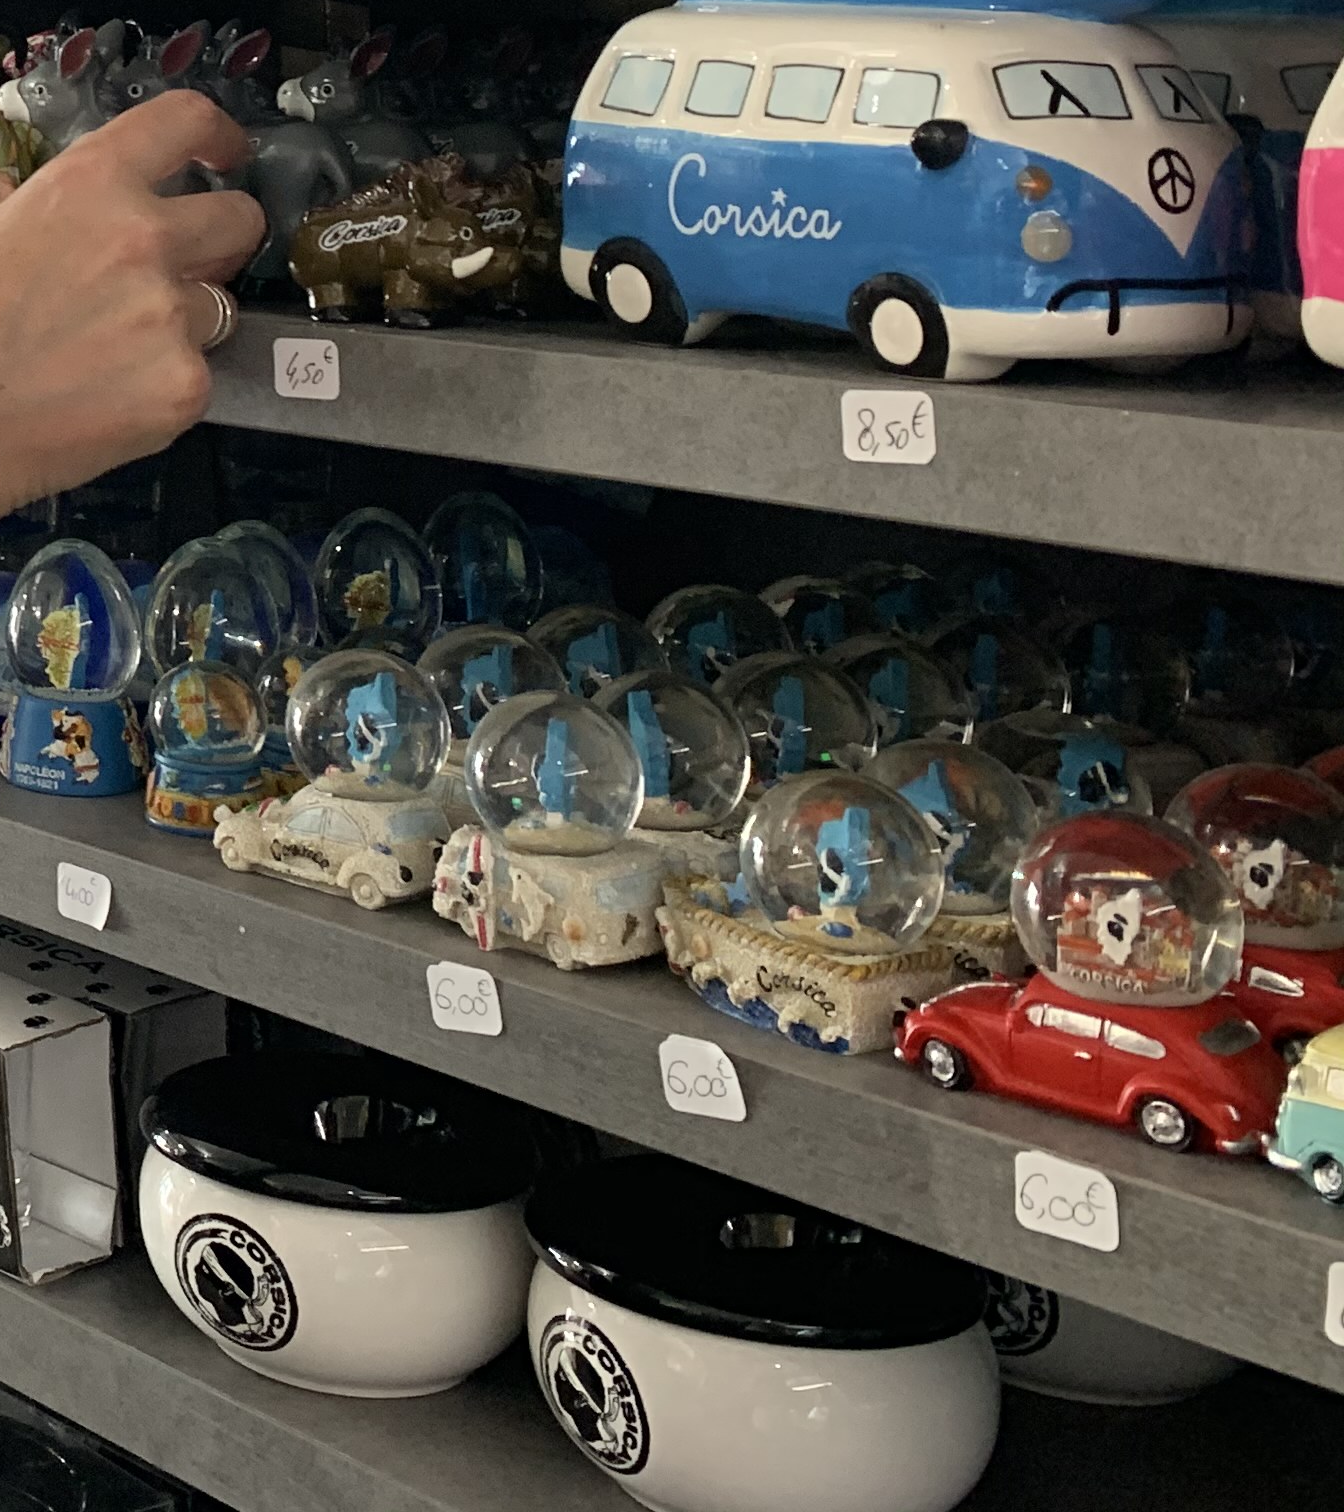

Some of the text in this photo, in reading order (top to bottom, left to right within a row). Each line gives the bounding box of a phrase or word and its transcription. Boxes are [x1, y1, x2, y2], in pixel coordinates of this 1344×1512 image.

[667, 151, 843, 242] Corsica
[318, 214, 408, 251] Corsica
[285, 345, 333, 389] 4,50€
[856, 400, 928, 456] 8,50€
[755, 964, 839, 1019] Corsica
[1070, 967, 1144, 993] CORSICA
[226, 1228, 293, 1342] CORSICA
[580, 1332, 640, 1468] CORSICA
